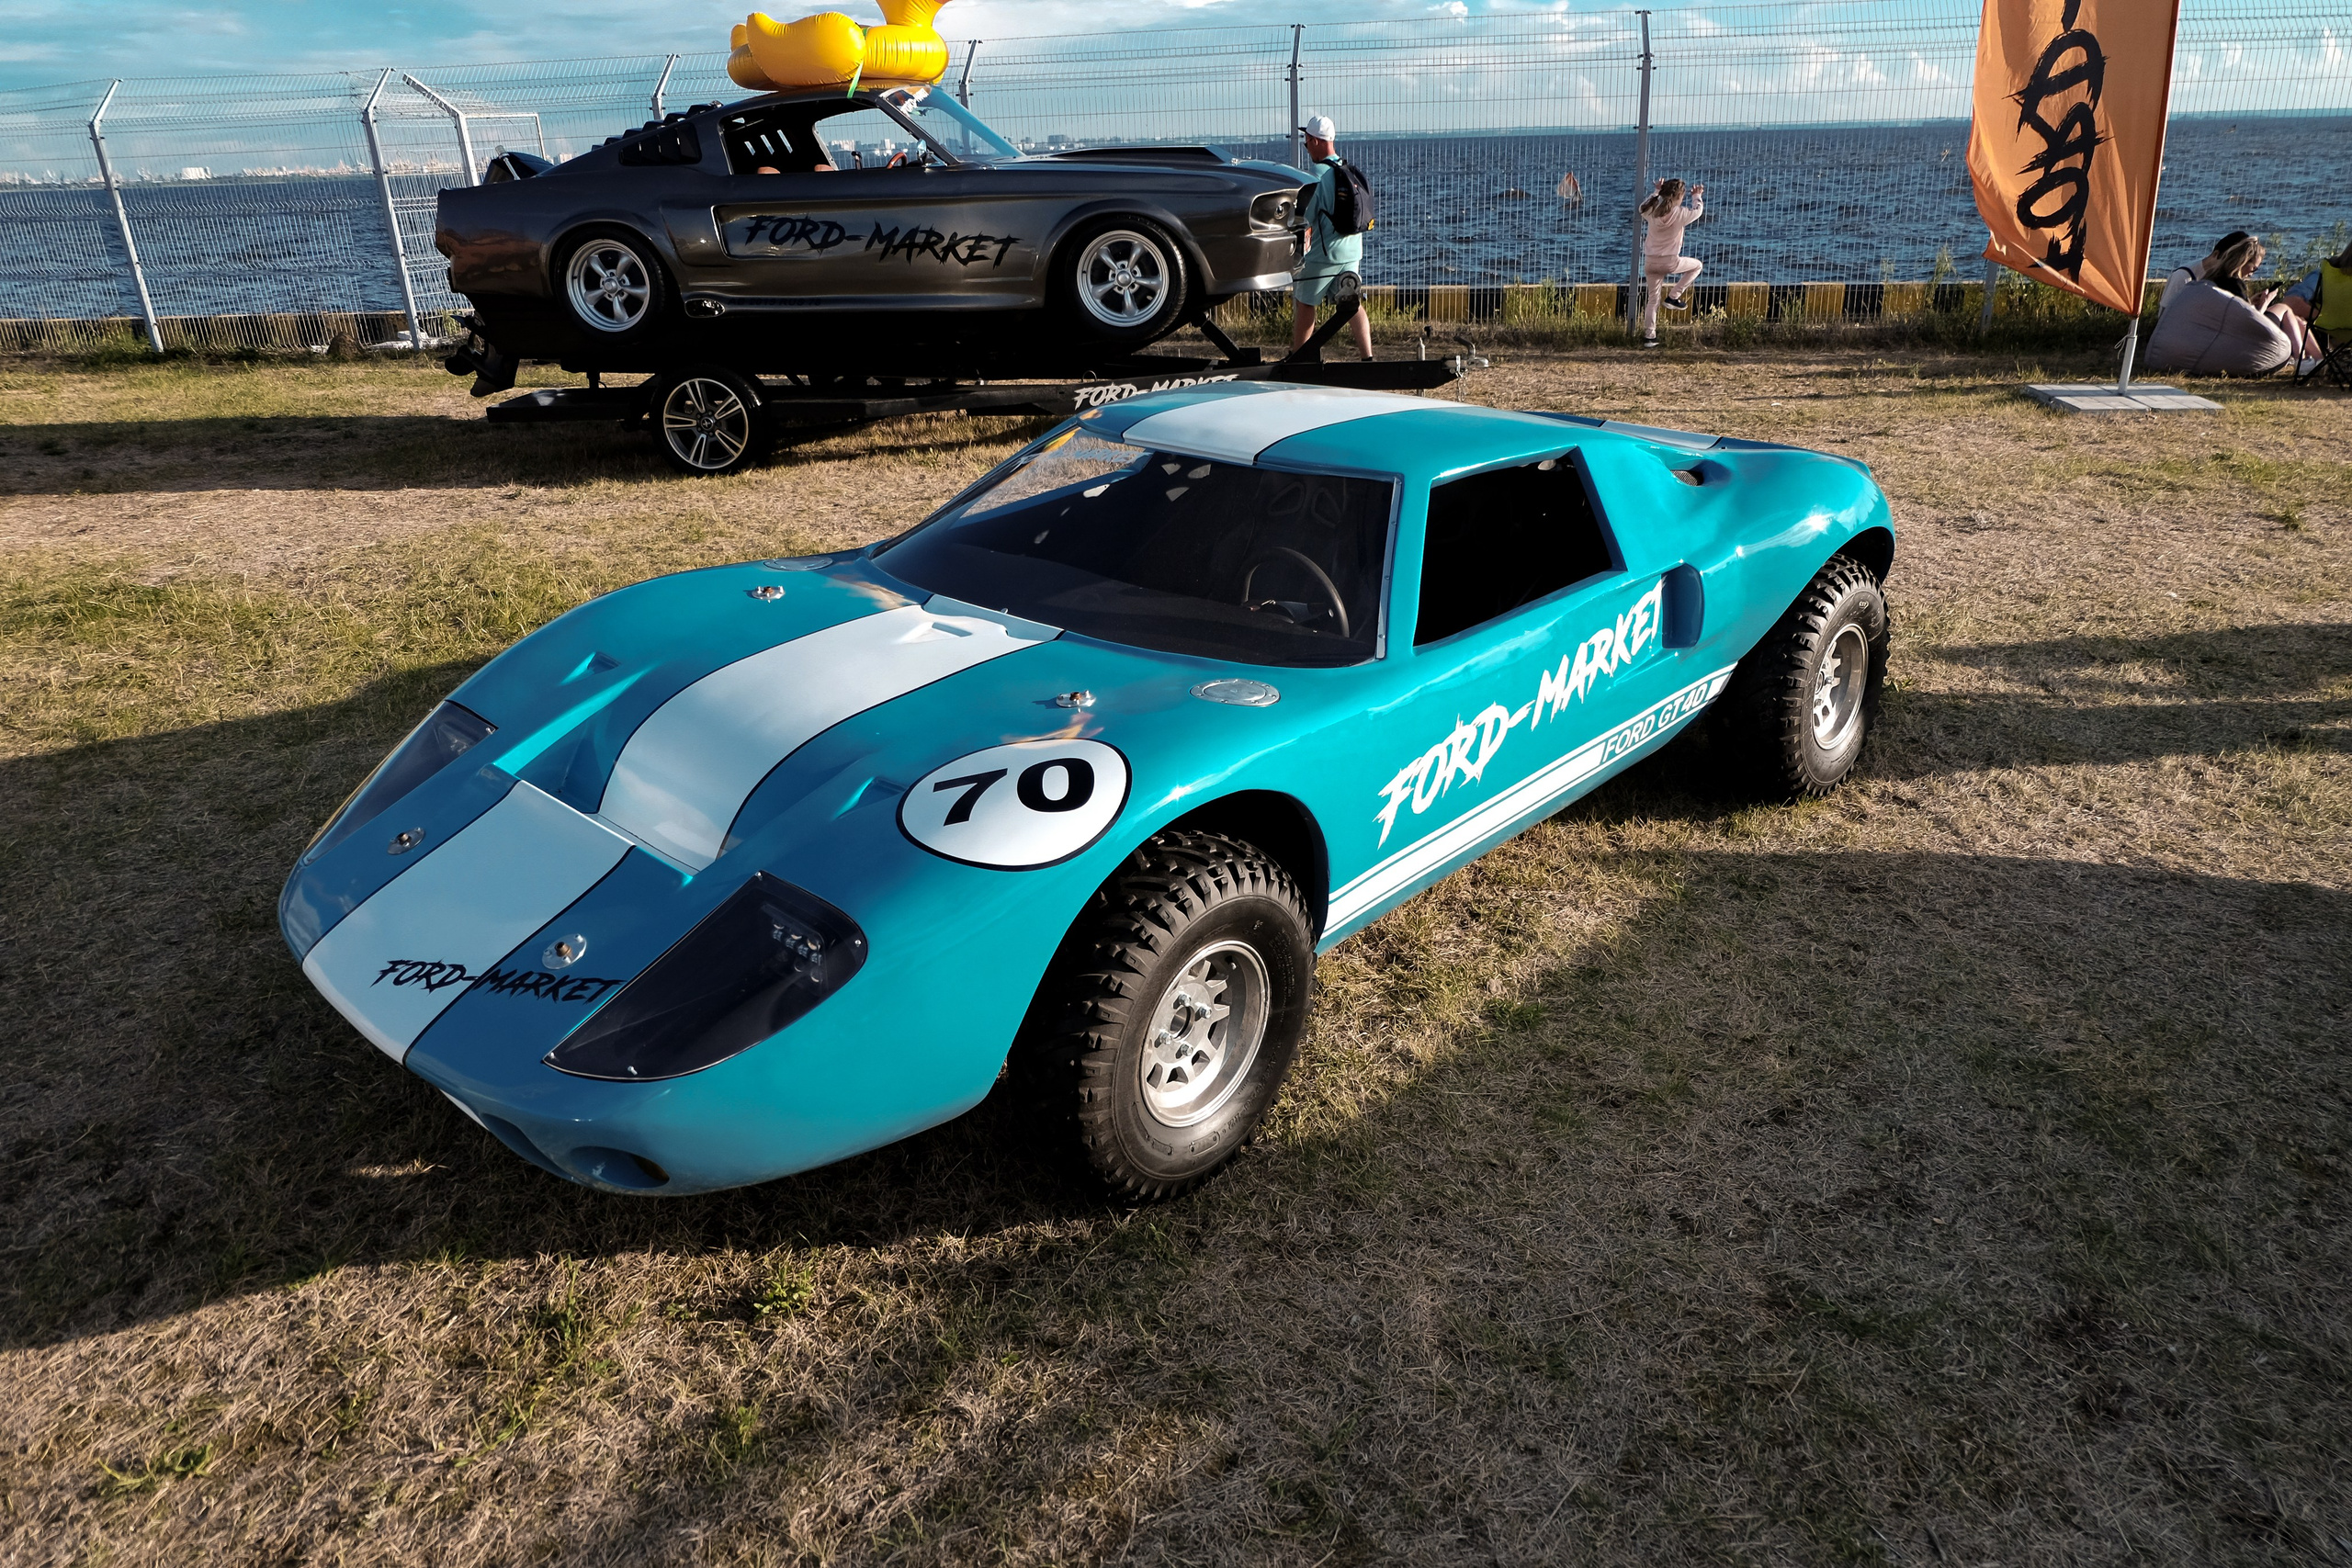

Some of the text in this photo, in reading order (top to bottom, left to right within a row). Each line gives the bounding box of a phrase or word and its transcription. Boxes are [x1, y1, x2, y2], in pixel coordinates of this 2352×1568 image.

[744, 212, 1024, 270] FORD-MARKET
[1073, 375, 1238, 412] FORD-M
[1373, 574, 1668, 851] FORD-MARKET
[1601, 714, 1655, 763] FORD
[933, 757, 1096, 828] 70
[369, 957, 629, 1006] FORD-MARKET
